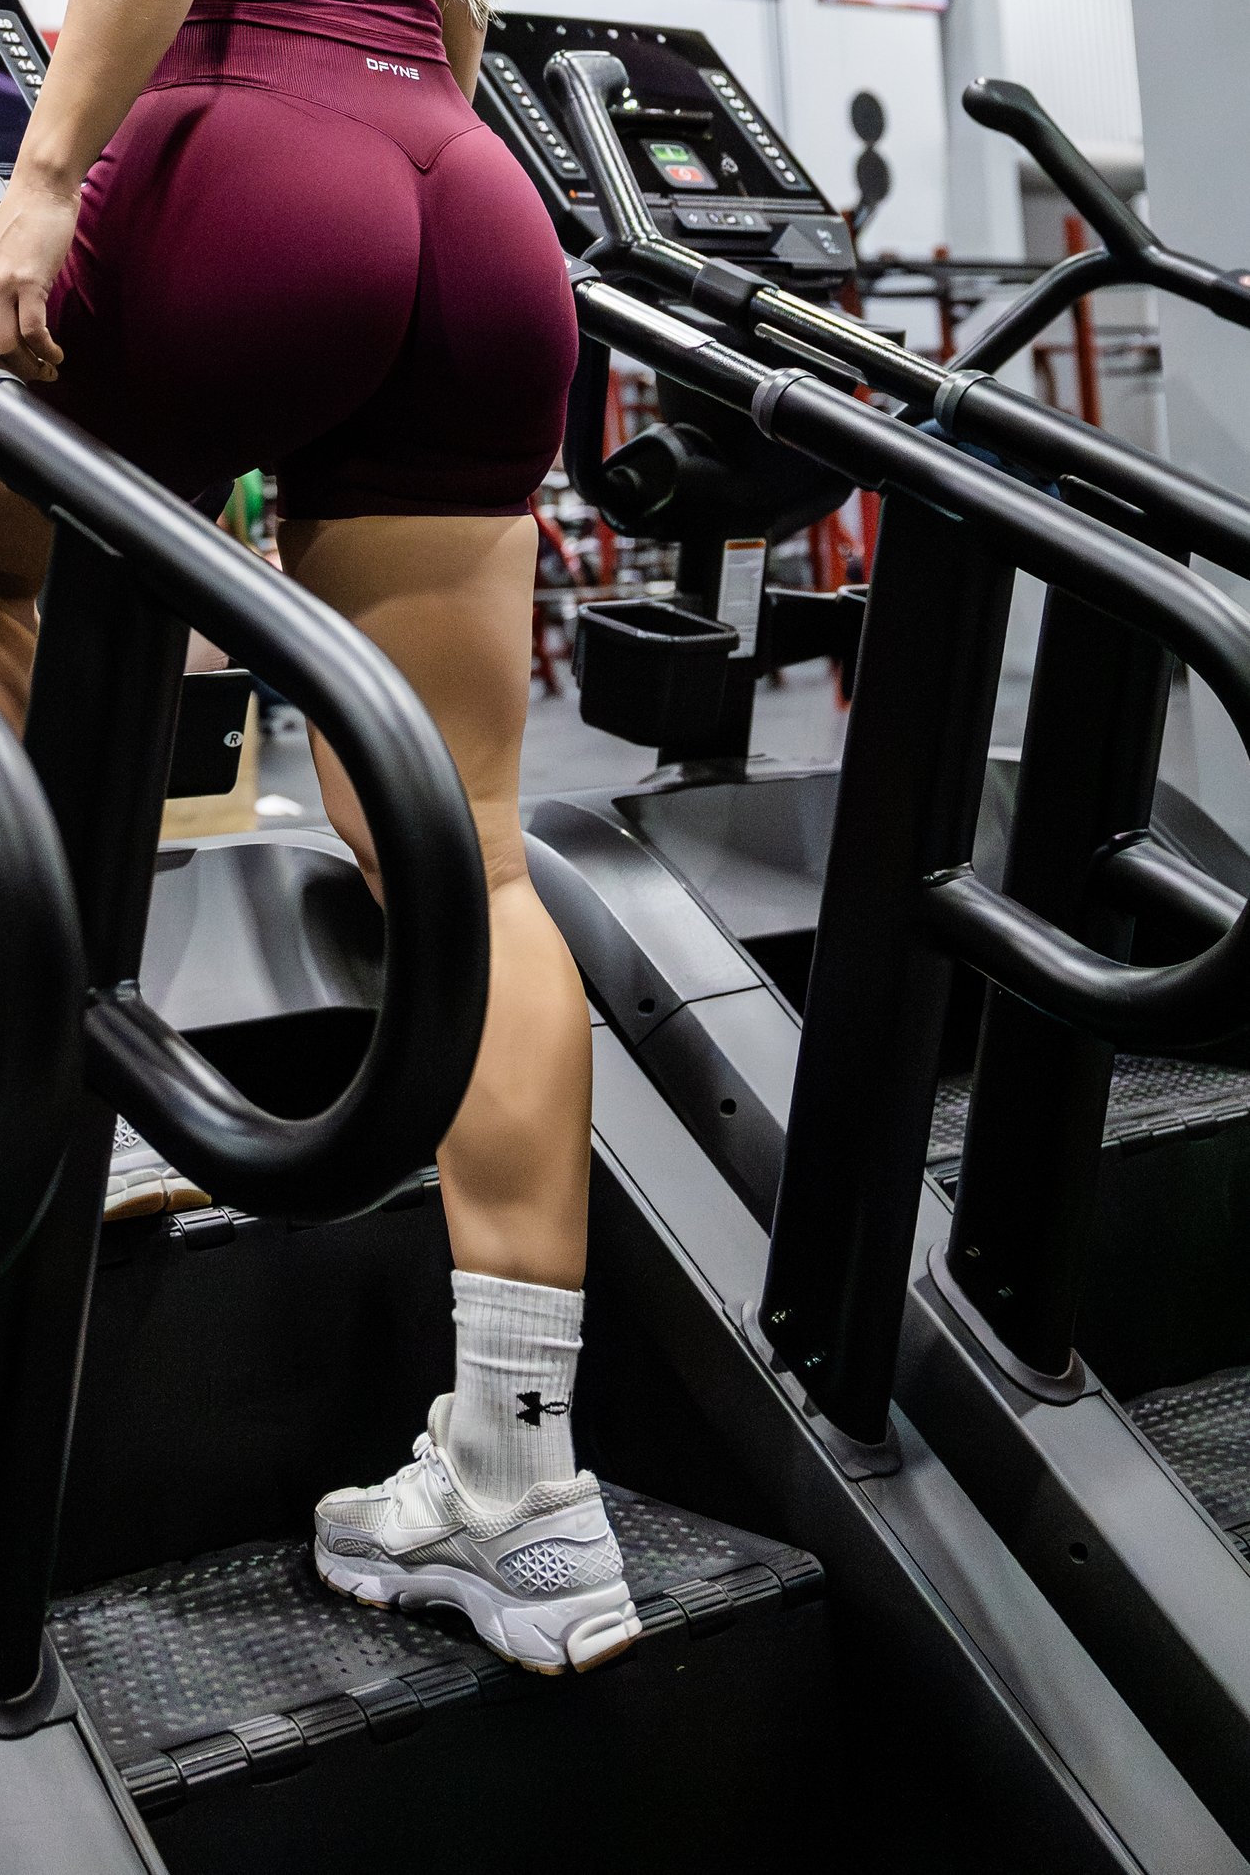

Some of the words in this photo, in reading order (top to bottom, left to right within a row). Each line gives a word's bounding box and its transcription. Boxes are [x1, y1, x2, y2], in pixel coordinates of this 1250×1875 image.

[17, 60, 36, 71] 14
[366, 57, 420, 80] DFYNE
[25, 74, 44, 85] 12
